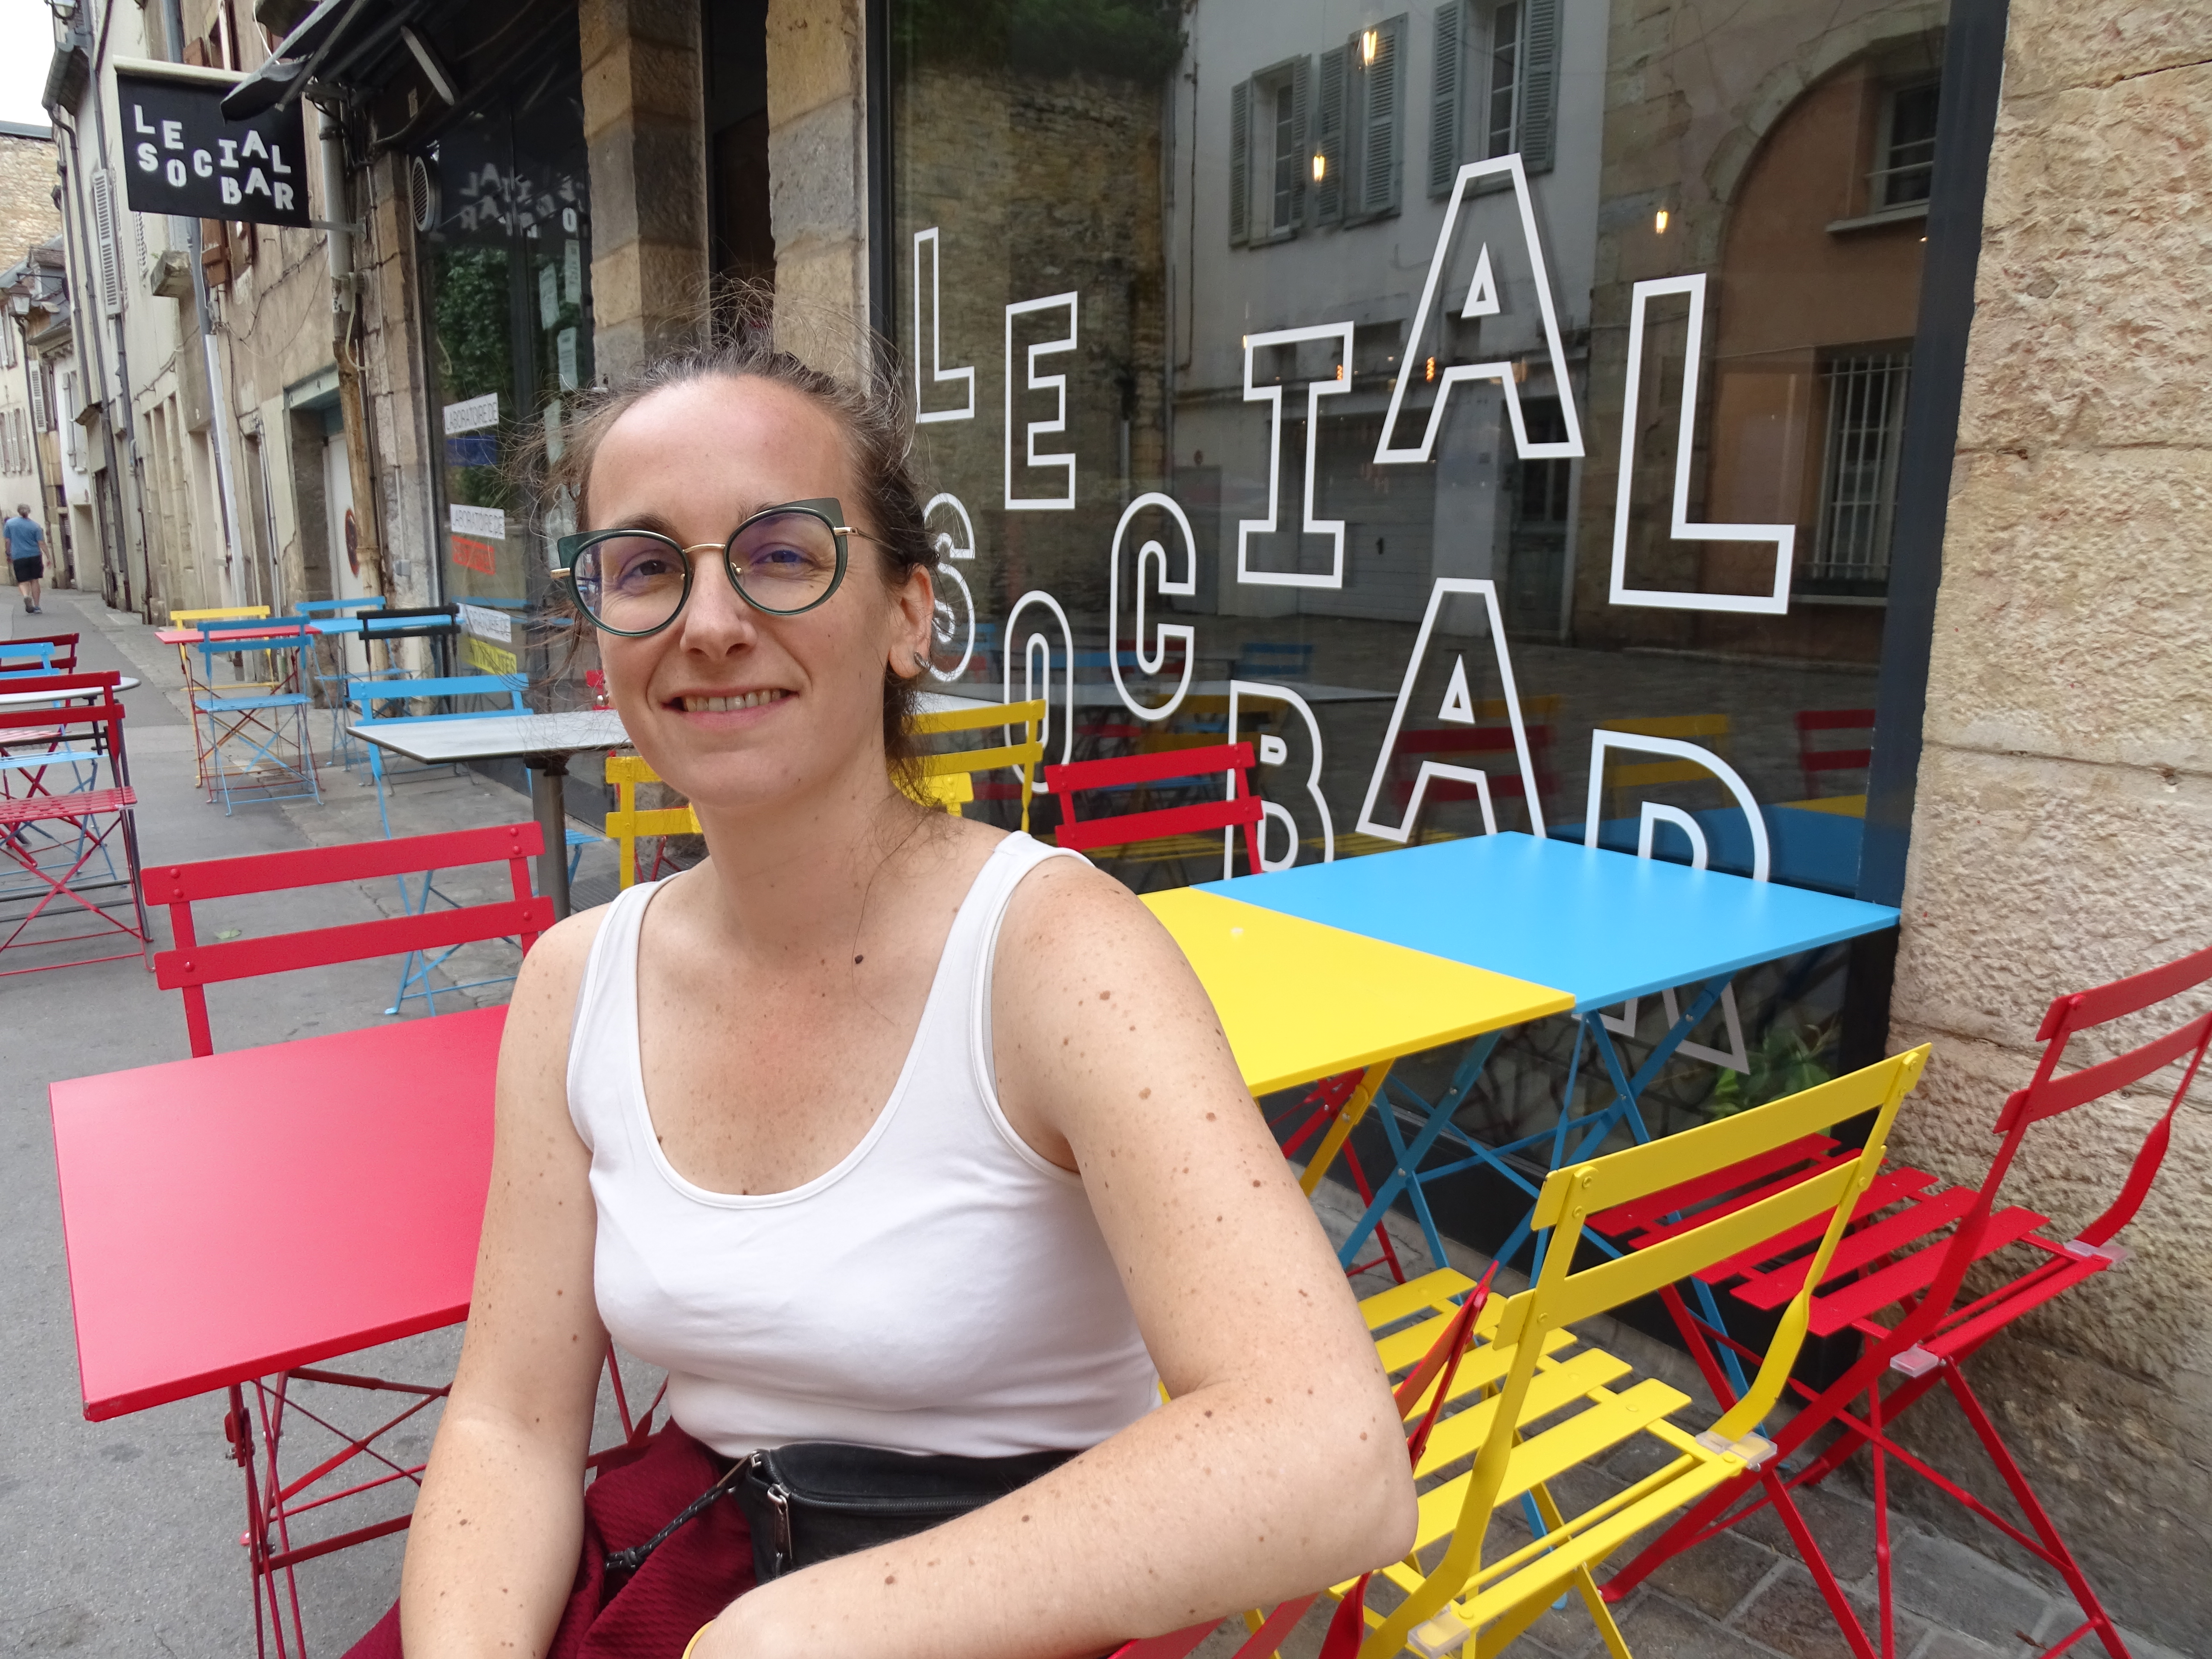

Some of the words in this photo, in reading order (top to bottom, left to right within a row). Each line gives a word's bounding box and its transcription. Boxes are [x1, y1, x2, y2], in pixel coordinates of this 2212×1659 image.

[134, 104, 184, 150] LE
[137, 130, 291, 188] SOCIAL
[221, 167, 294, 210] BAR
[914, 227, 1078, 509] LE
[924, 152, 1795, 793] SOCIAL
